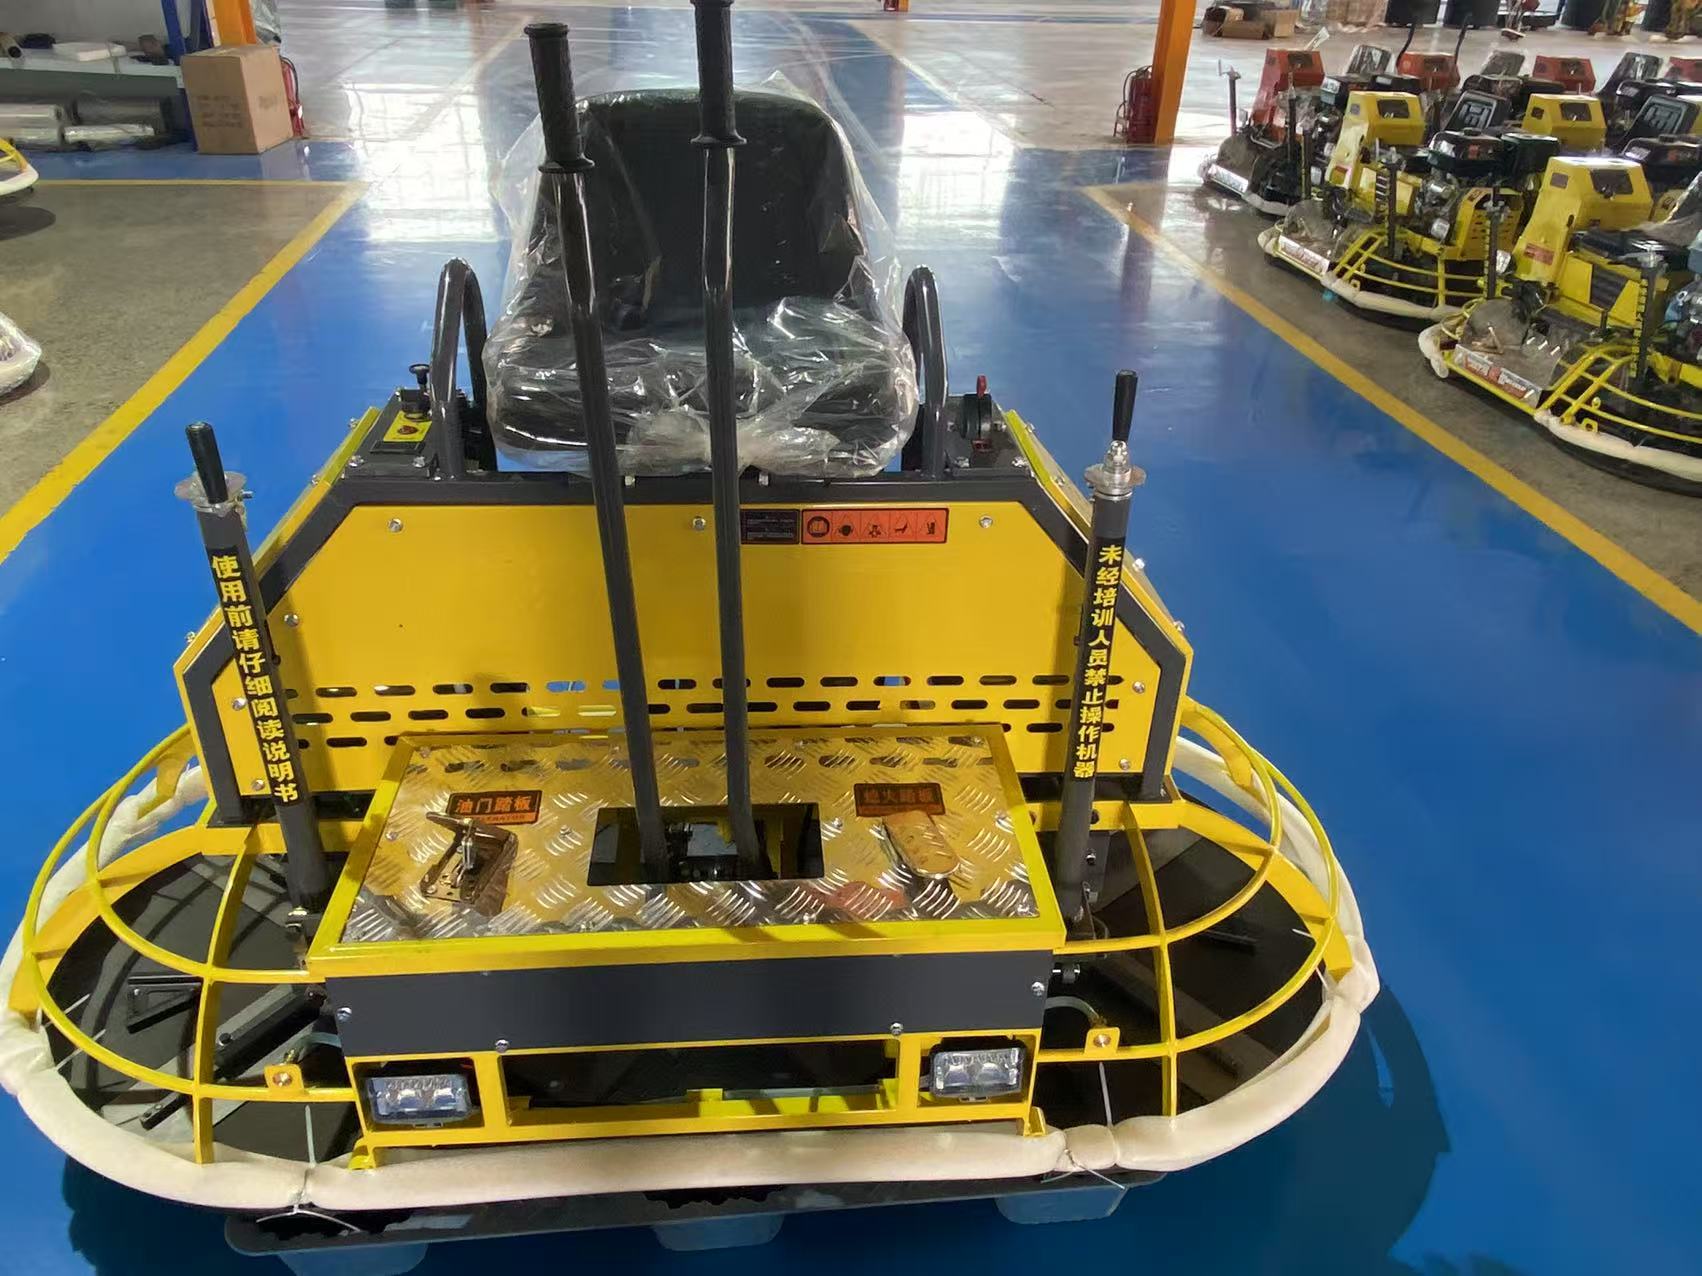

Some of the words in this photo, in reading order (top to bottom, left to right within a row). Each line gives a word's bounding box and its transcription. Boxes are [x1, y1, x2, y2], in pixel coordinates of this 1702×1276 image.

[212, 556, 298, 802] 使用前请仔细阅读说明书
[1073, 544, 1122, 778] 未经培训人员禁止操作机器
